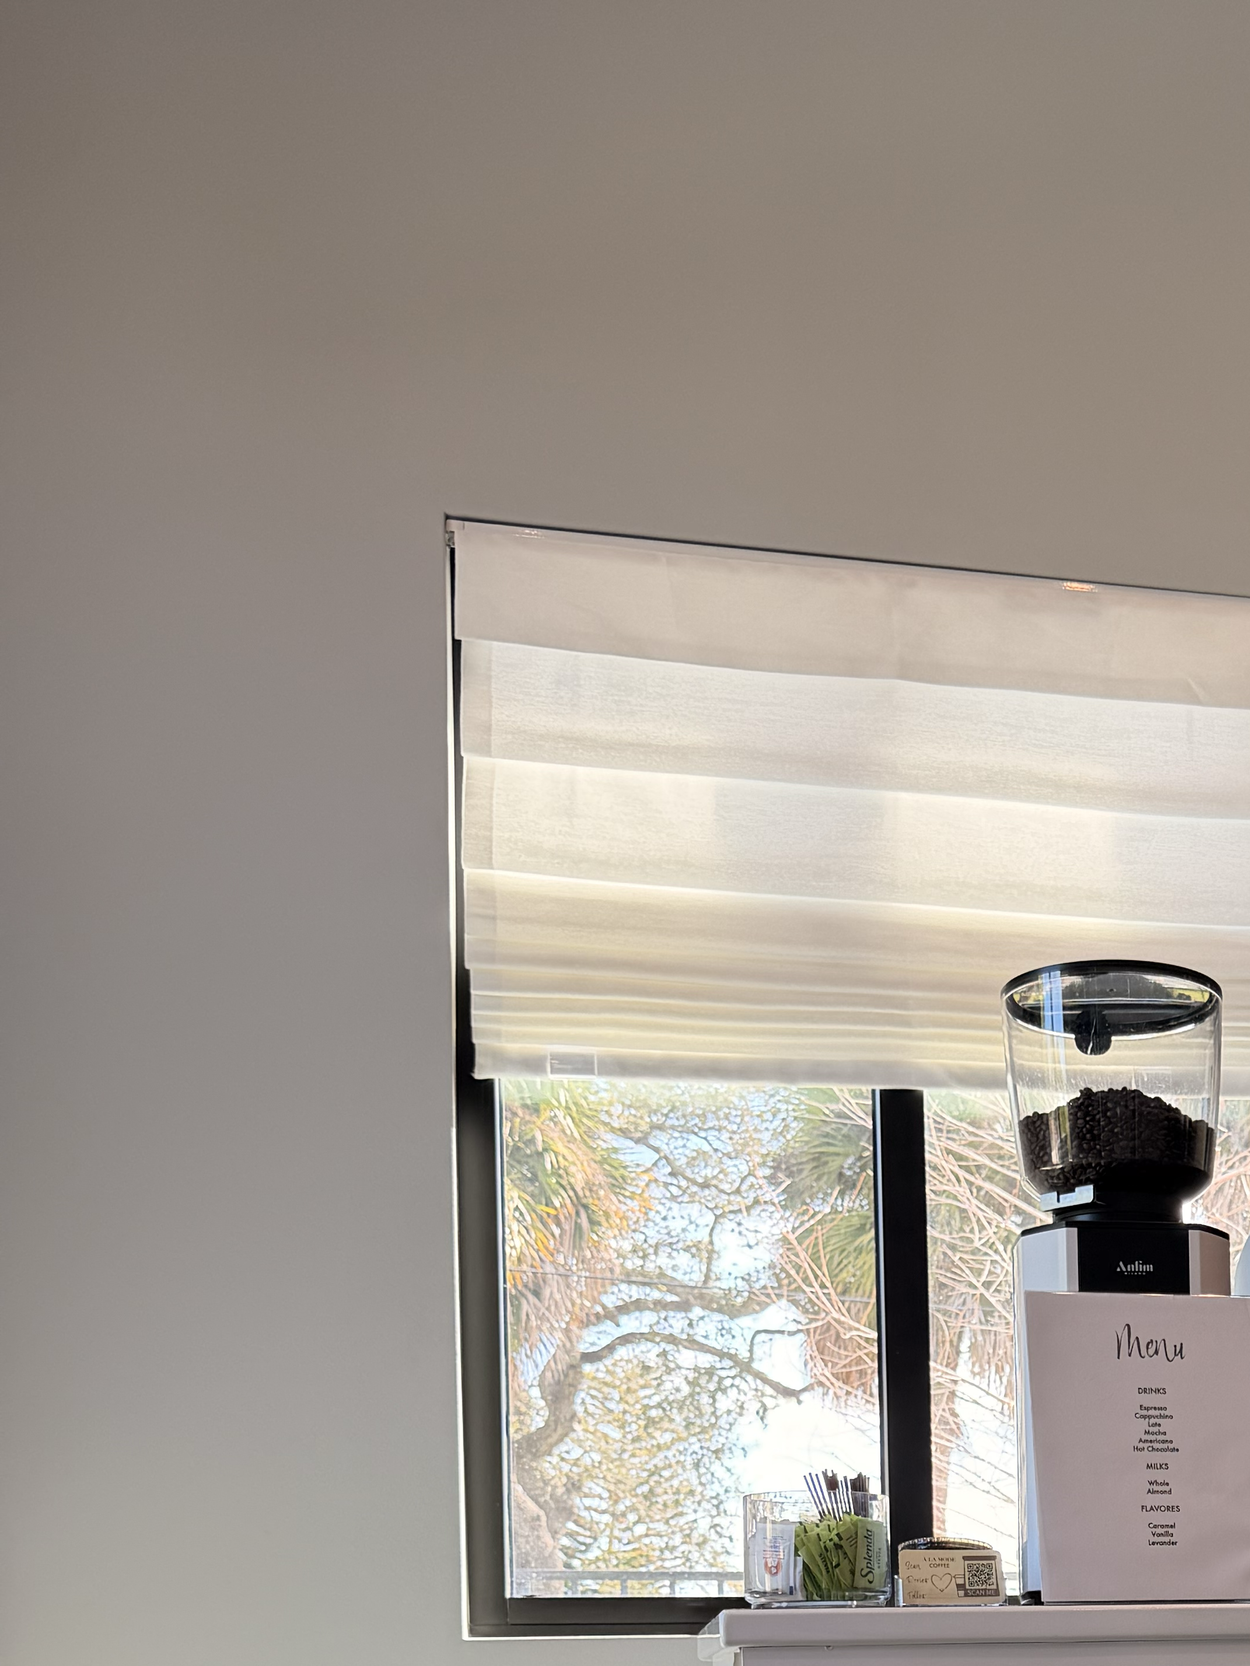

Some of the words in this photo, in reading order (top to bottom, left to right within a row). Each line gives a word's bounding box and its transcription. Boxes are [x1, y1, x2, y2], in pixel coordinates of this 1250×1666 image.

[1116, 1260, 1154, 1272] Anfim
[1115, 1323, 1186, 1363] Menu
[1137, 1386, 1167, 1396] DRINKS
[1139, 1404, 1168, 1413] Espresso
[1143, 1428, 1167, 1437] Mocha
[1137, 1436, 1174, 1445] Americano
[1132, 1445, 1146, 1453] Hot
[1146, 1445, 1180, 1453] Chocolate
[1145, 1462, 1170, 1471] MILKS
[1147, 1479, 1170, 1487] Whole
[1146, 1487, 1173, 1496] Almond
[1140, 1504, 1181, 1513] FLAVORES
[1147, 1521, 1176, 1530] Caramel
[1150, 1530, 1174, 1539] Vanilla
[859, 1528, 875, 1585] Splenda
